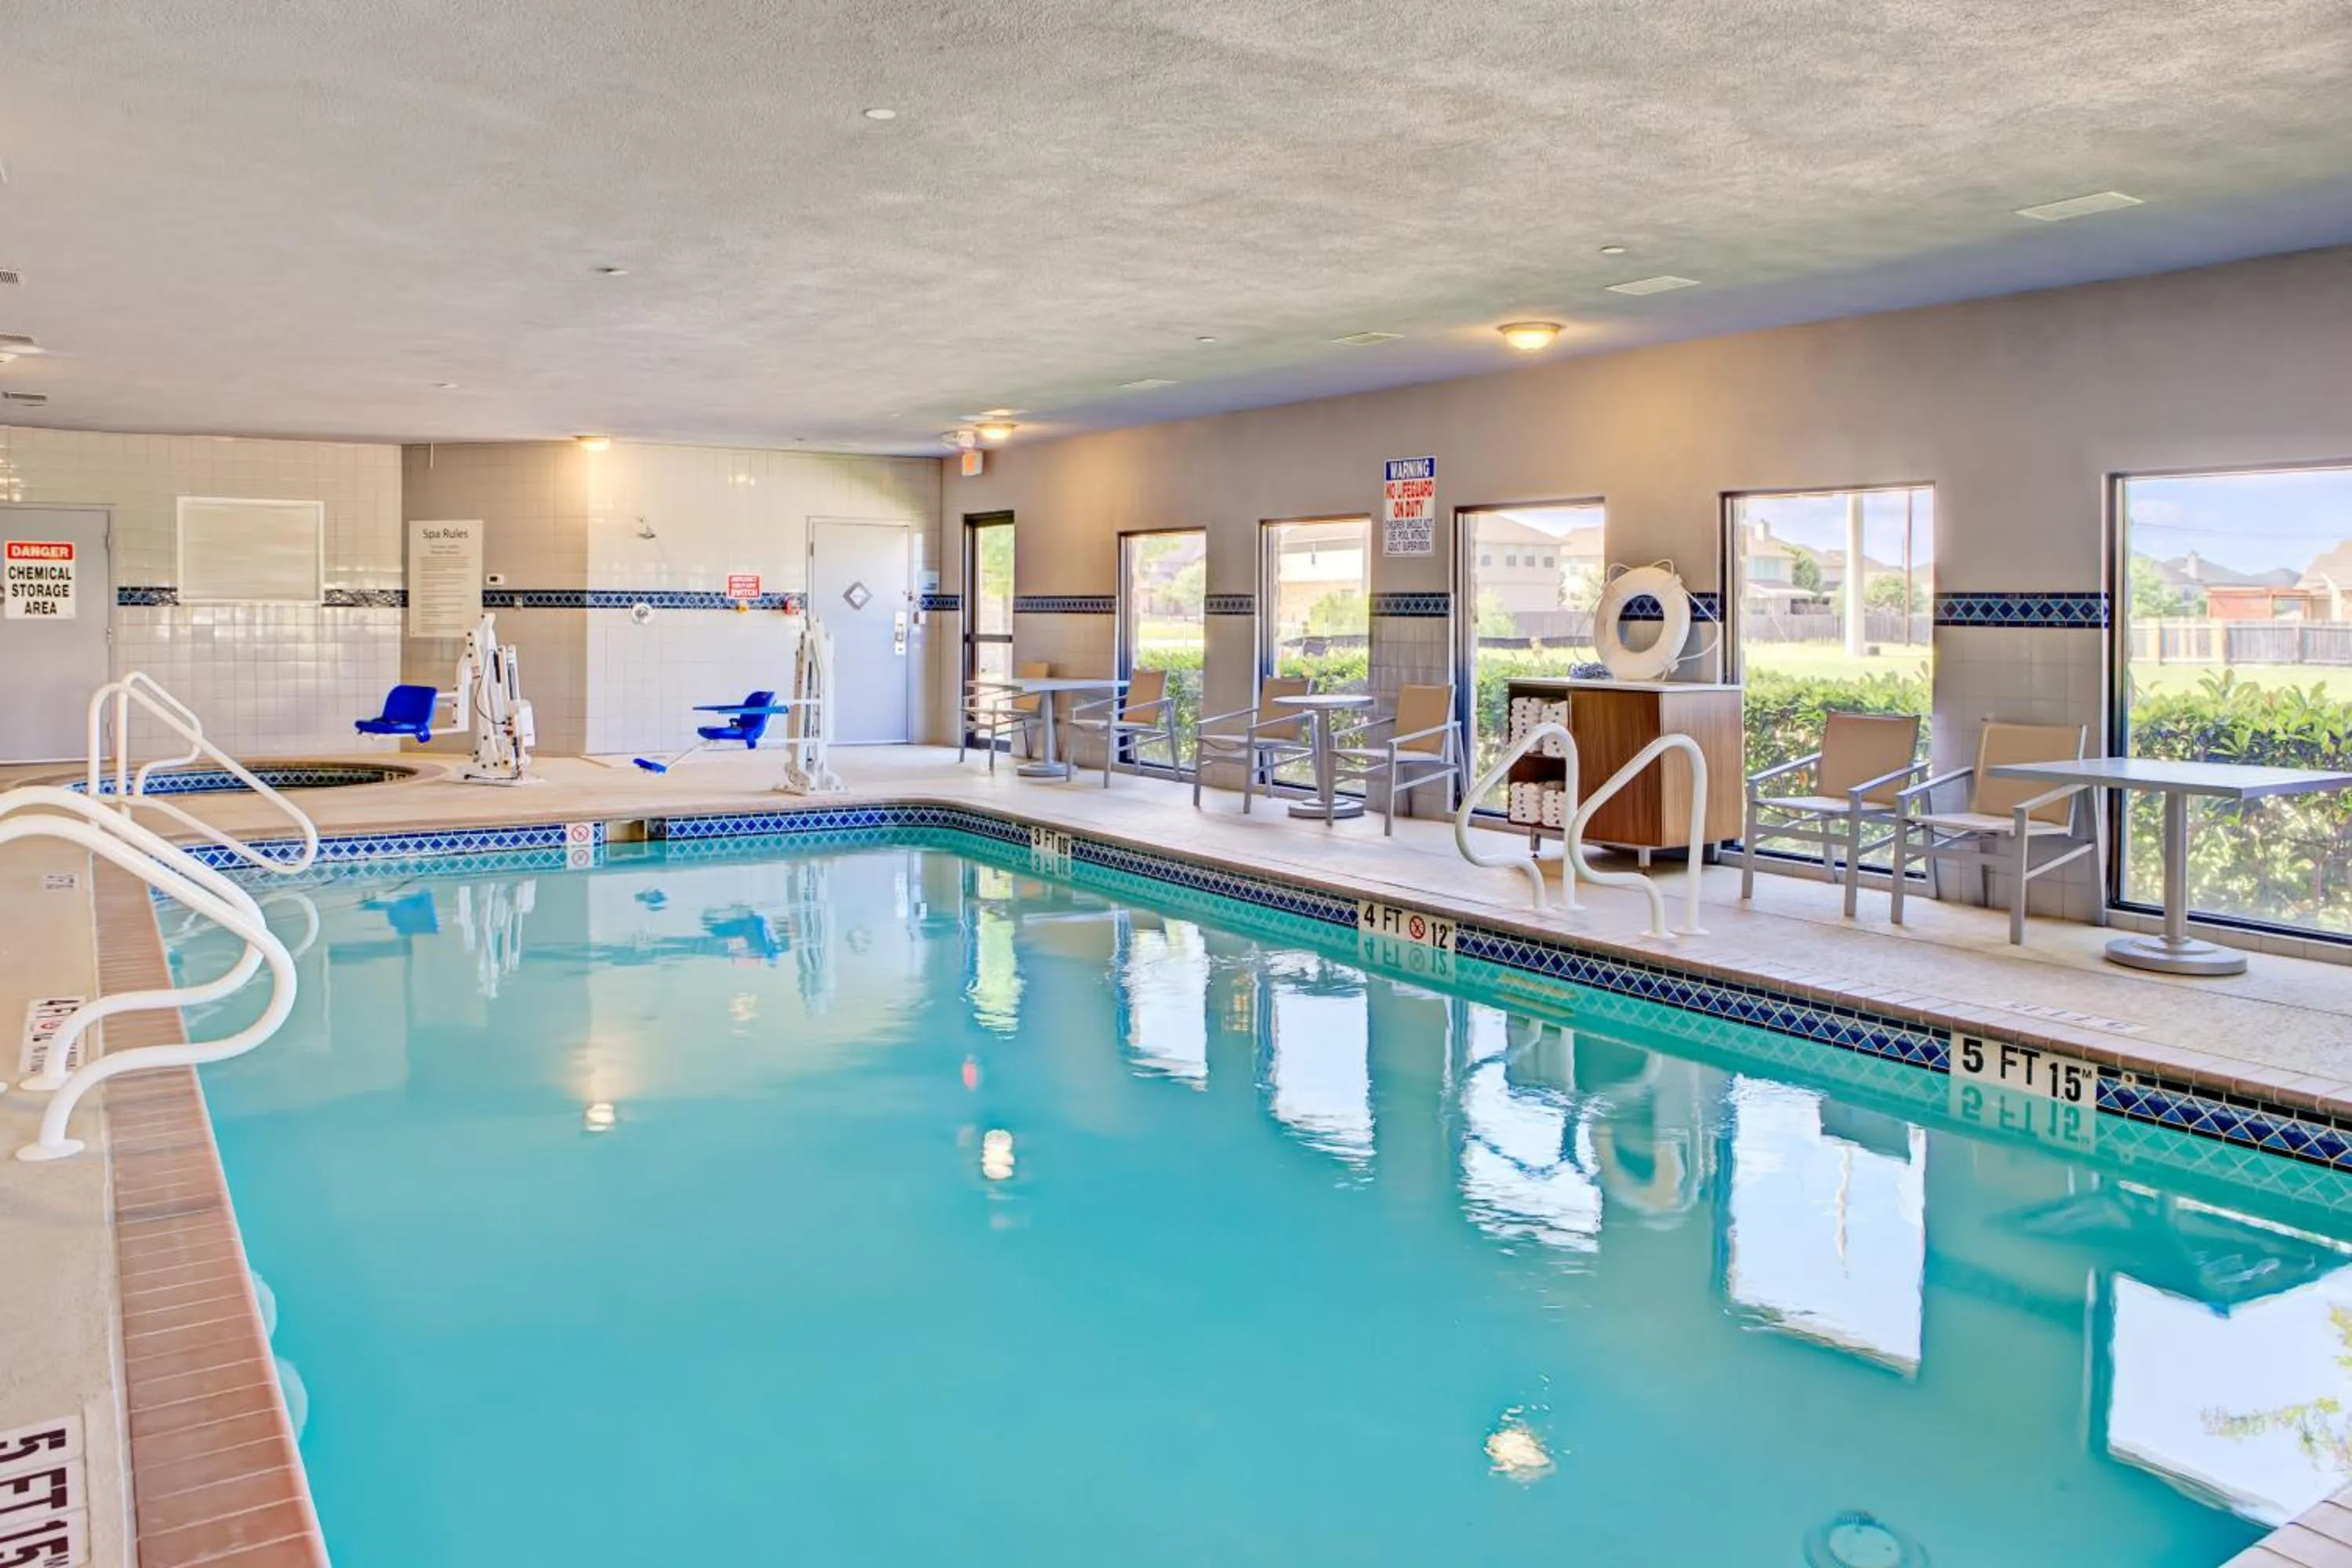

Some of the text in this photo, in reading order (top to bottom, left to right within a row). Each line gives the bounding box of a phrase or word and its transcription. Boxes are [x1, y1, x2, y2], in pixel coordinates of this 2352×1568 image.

[1390, 459, 1430, 479] WARNING
[1386, 480, 1433, 499] NO LIFEGUARD
[1394, 500, 1424, 517] ON DUTY
[423, 528, 469, 539] Spa Rules
[11, 545, 70, 557] DANGER
[9, 566, 72, 580] CHEMICAL
[12, 583, 69, 597] STORAGE
[24, 601, 57, 615] AREA
[1035, 828, 1040, 845] 3
[1044, 830, 1056, 851] FT
[1364, 904, 1375, 927] 4
[1384, 906, 1403, 934] FT
[1962, 1038, 1984, 1073] 5
[2000, 1044, 2041, 1085] FT
